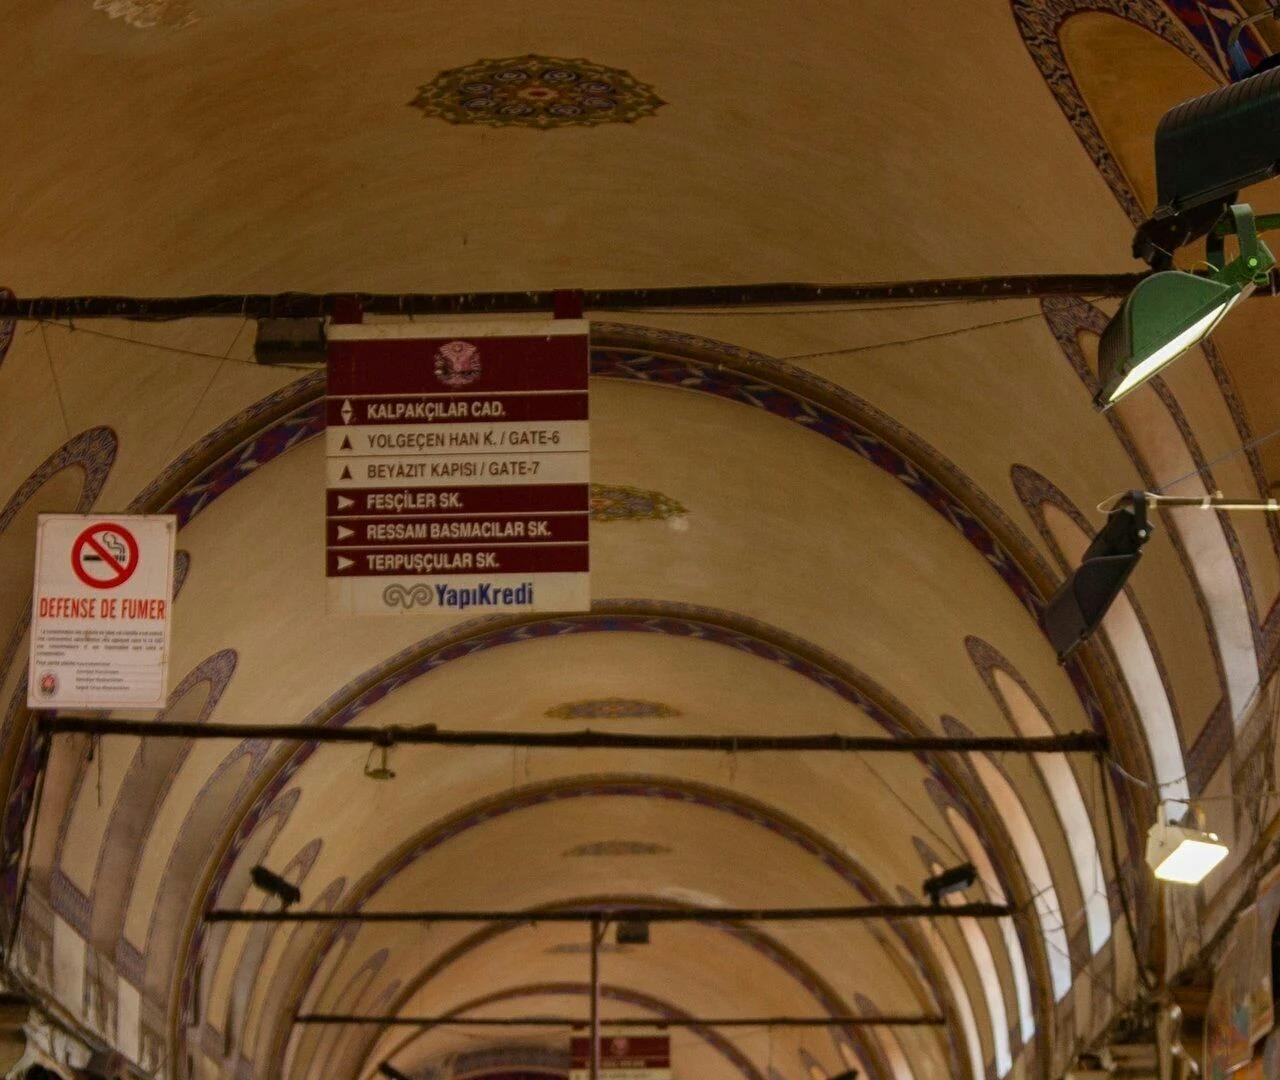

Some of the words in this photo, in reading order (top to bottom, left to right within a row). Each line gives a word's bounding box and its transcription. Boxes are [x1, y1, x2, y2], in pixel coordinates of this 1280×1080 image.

[367, 402, 468, 421] KALPAKÇILAR
[471, 401, 506, 418] CAD.
[367, 433, 445, 451] YOLGEÇEN
[449, 432, 480, 447] HAN
[484, 431, 497, 447] K.
[508, 430, 560, 446] GATE-6
[367, 463, 425, 479] BEYAZIT
[430, 461, 477, 477] KAPISI
[488, 461, 540, 476] GATE-7
[366, 490, 436, 511] FESÇİLER
[439, 492, 463, 507] SK.
[366, 524, 426, 540] RESSAM
[430, 522, 524, 538] BASMACILAR
[528, 521, 552, 537] SK.
[366, 553, 472, 573] TERPUŞÇULAR
[476, 552, 500, 568] SK.
[434, 582, 534, 610] YapıKredi
[39, 598, 95, 619] DEFENSE
[100, 598, 116, 619] DE
[121, 599, 165, 620] FUMER
